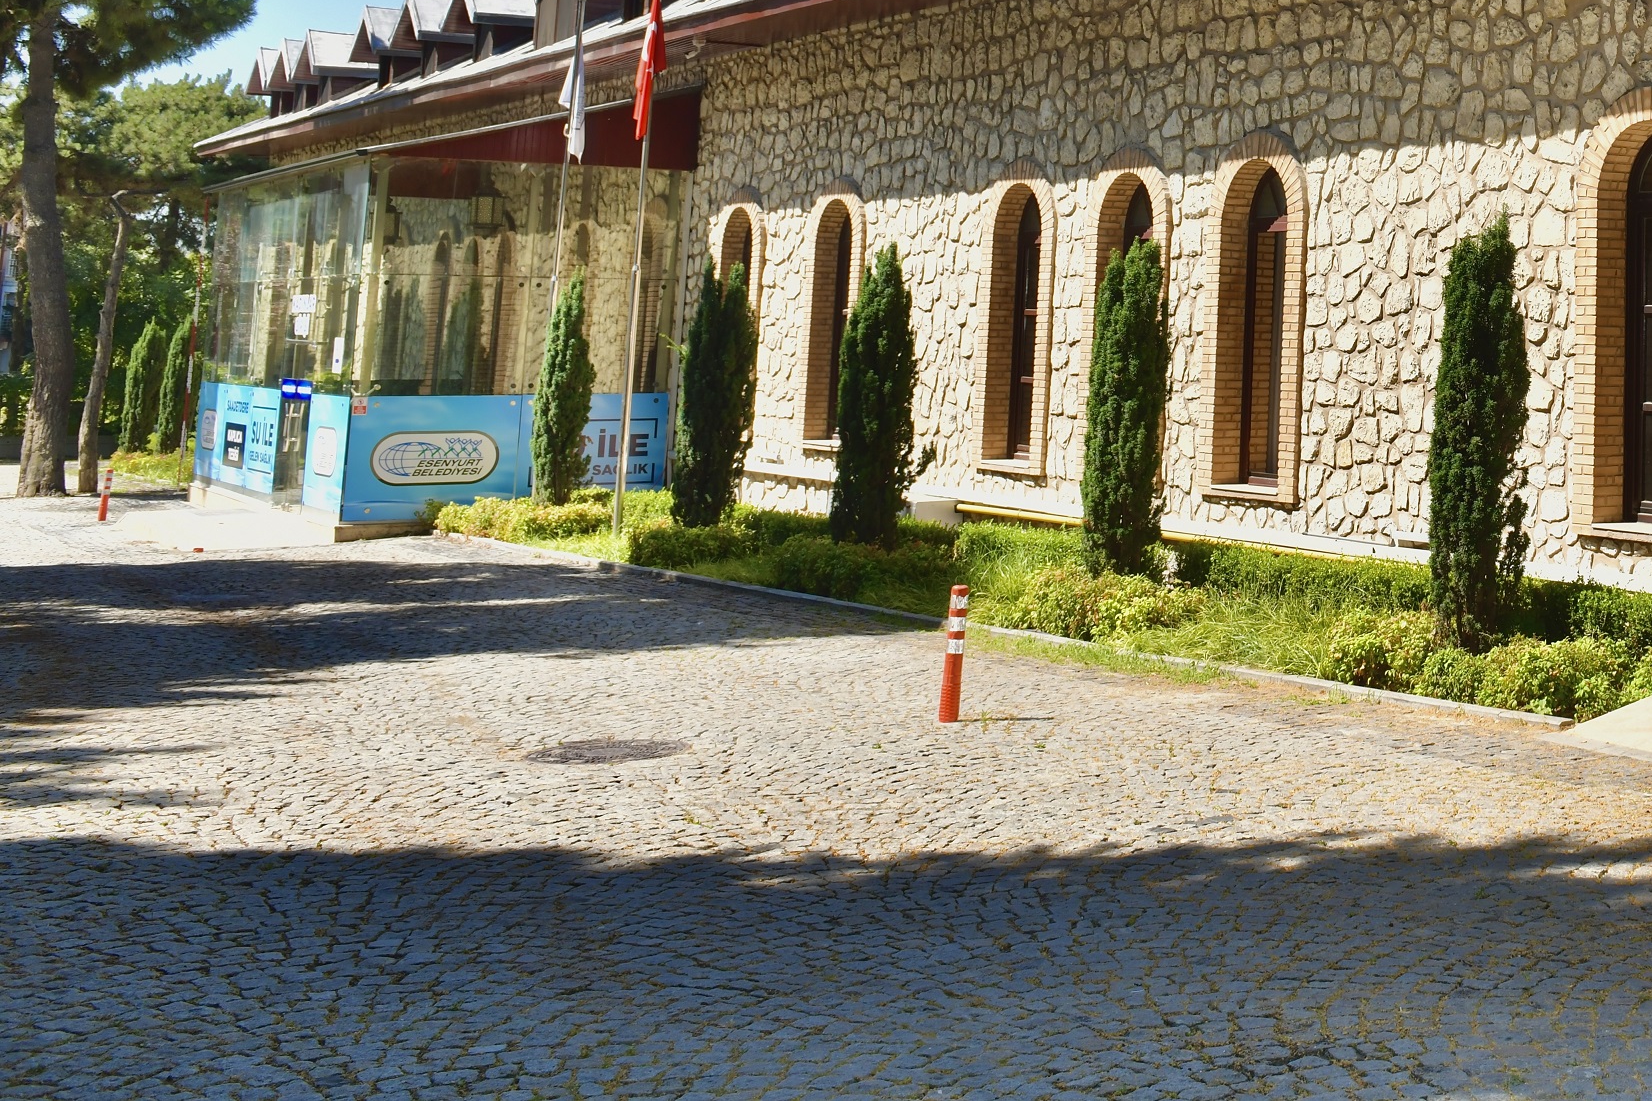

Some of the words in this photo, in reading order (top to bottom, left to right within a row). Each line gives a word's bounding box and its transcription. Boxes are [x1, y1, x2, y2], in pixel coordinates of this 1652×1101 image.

[251, 421, 262, 444] SU
[262, 417, 274, 447] İLE
[597, 429, 649, 457] İLE
[411, 466, 483, 477] BELEDİYESİ
[417, 458, 483, 468] ESENYURT
